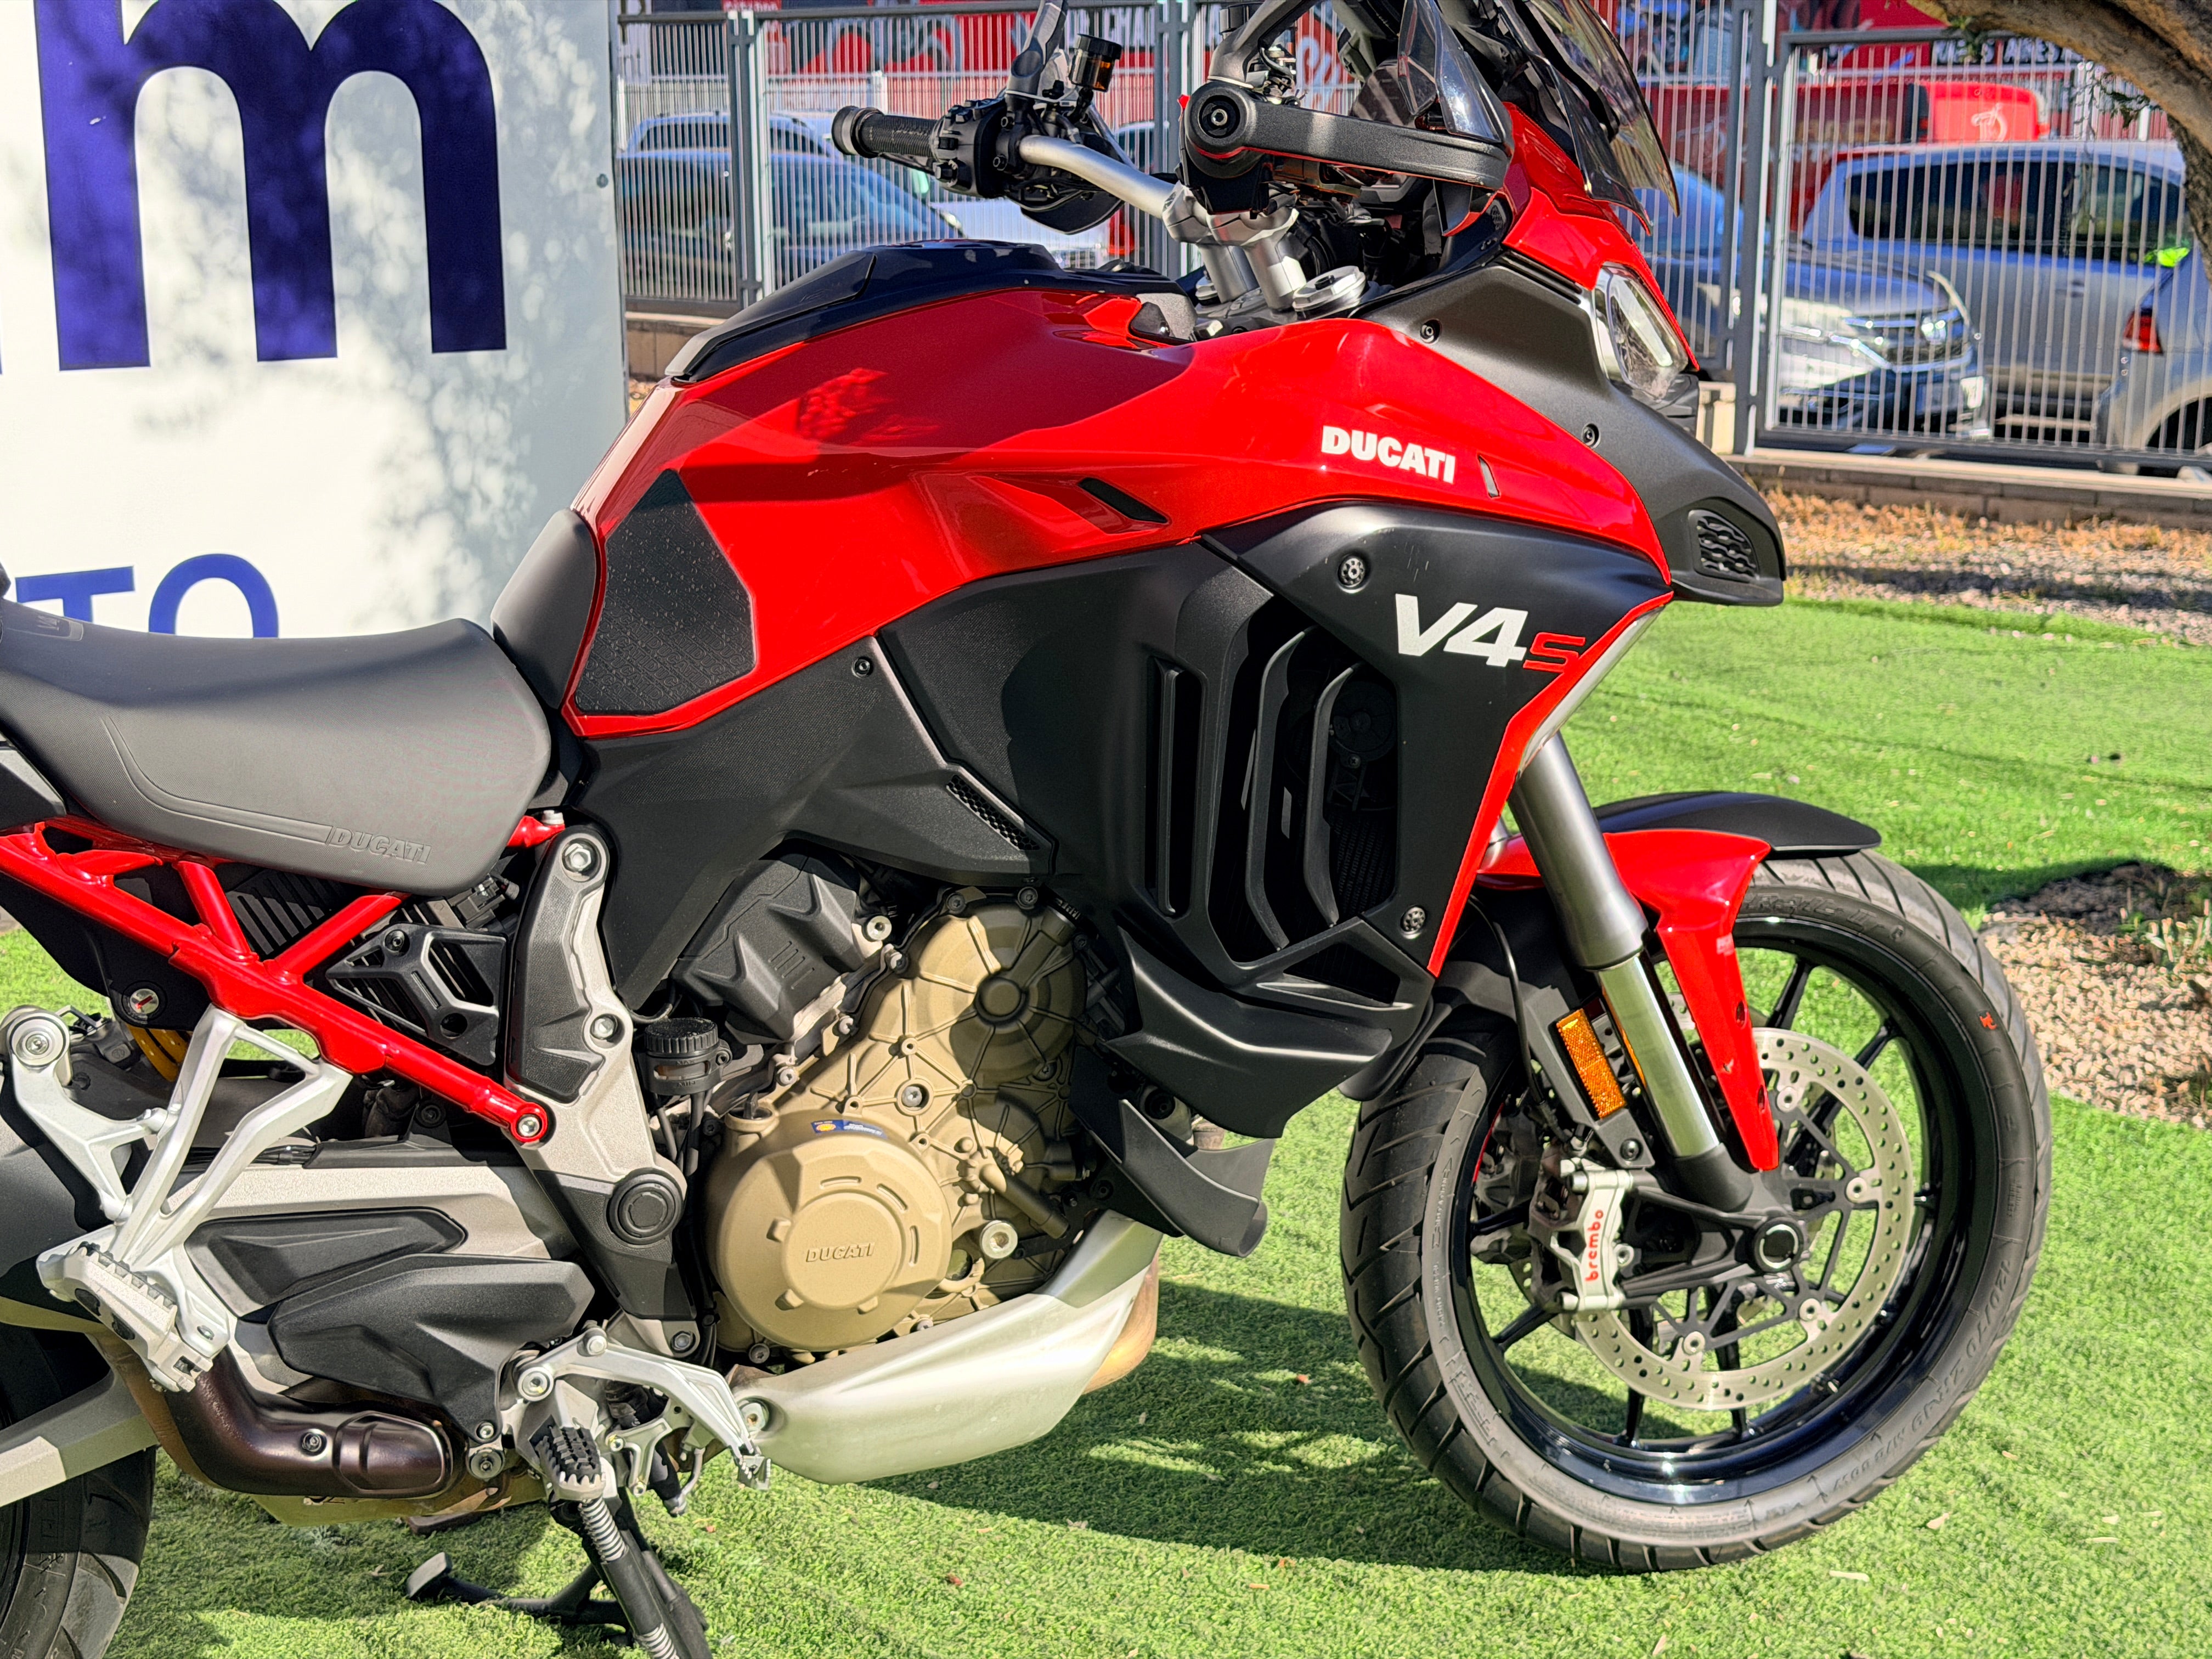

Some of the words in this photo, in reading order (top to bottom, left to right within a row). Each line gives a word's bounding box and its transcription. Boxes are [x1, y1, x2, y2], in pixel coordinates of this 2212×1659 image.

[1321, 426, 1456, 485] DUCATI
[328, 827, 432, 864] DUCATI
[806, 1242, 875, 1263] DUCATI
[1585, 1209, 1604, 1282] brembo
